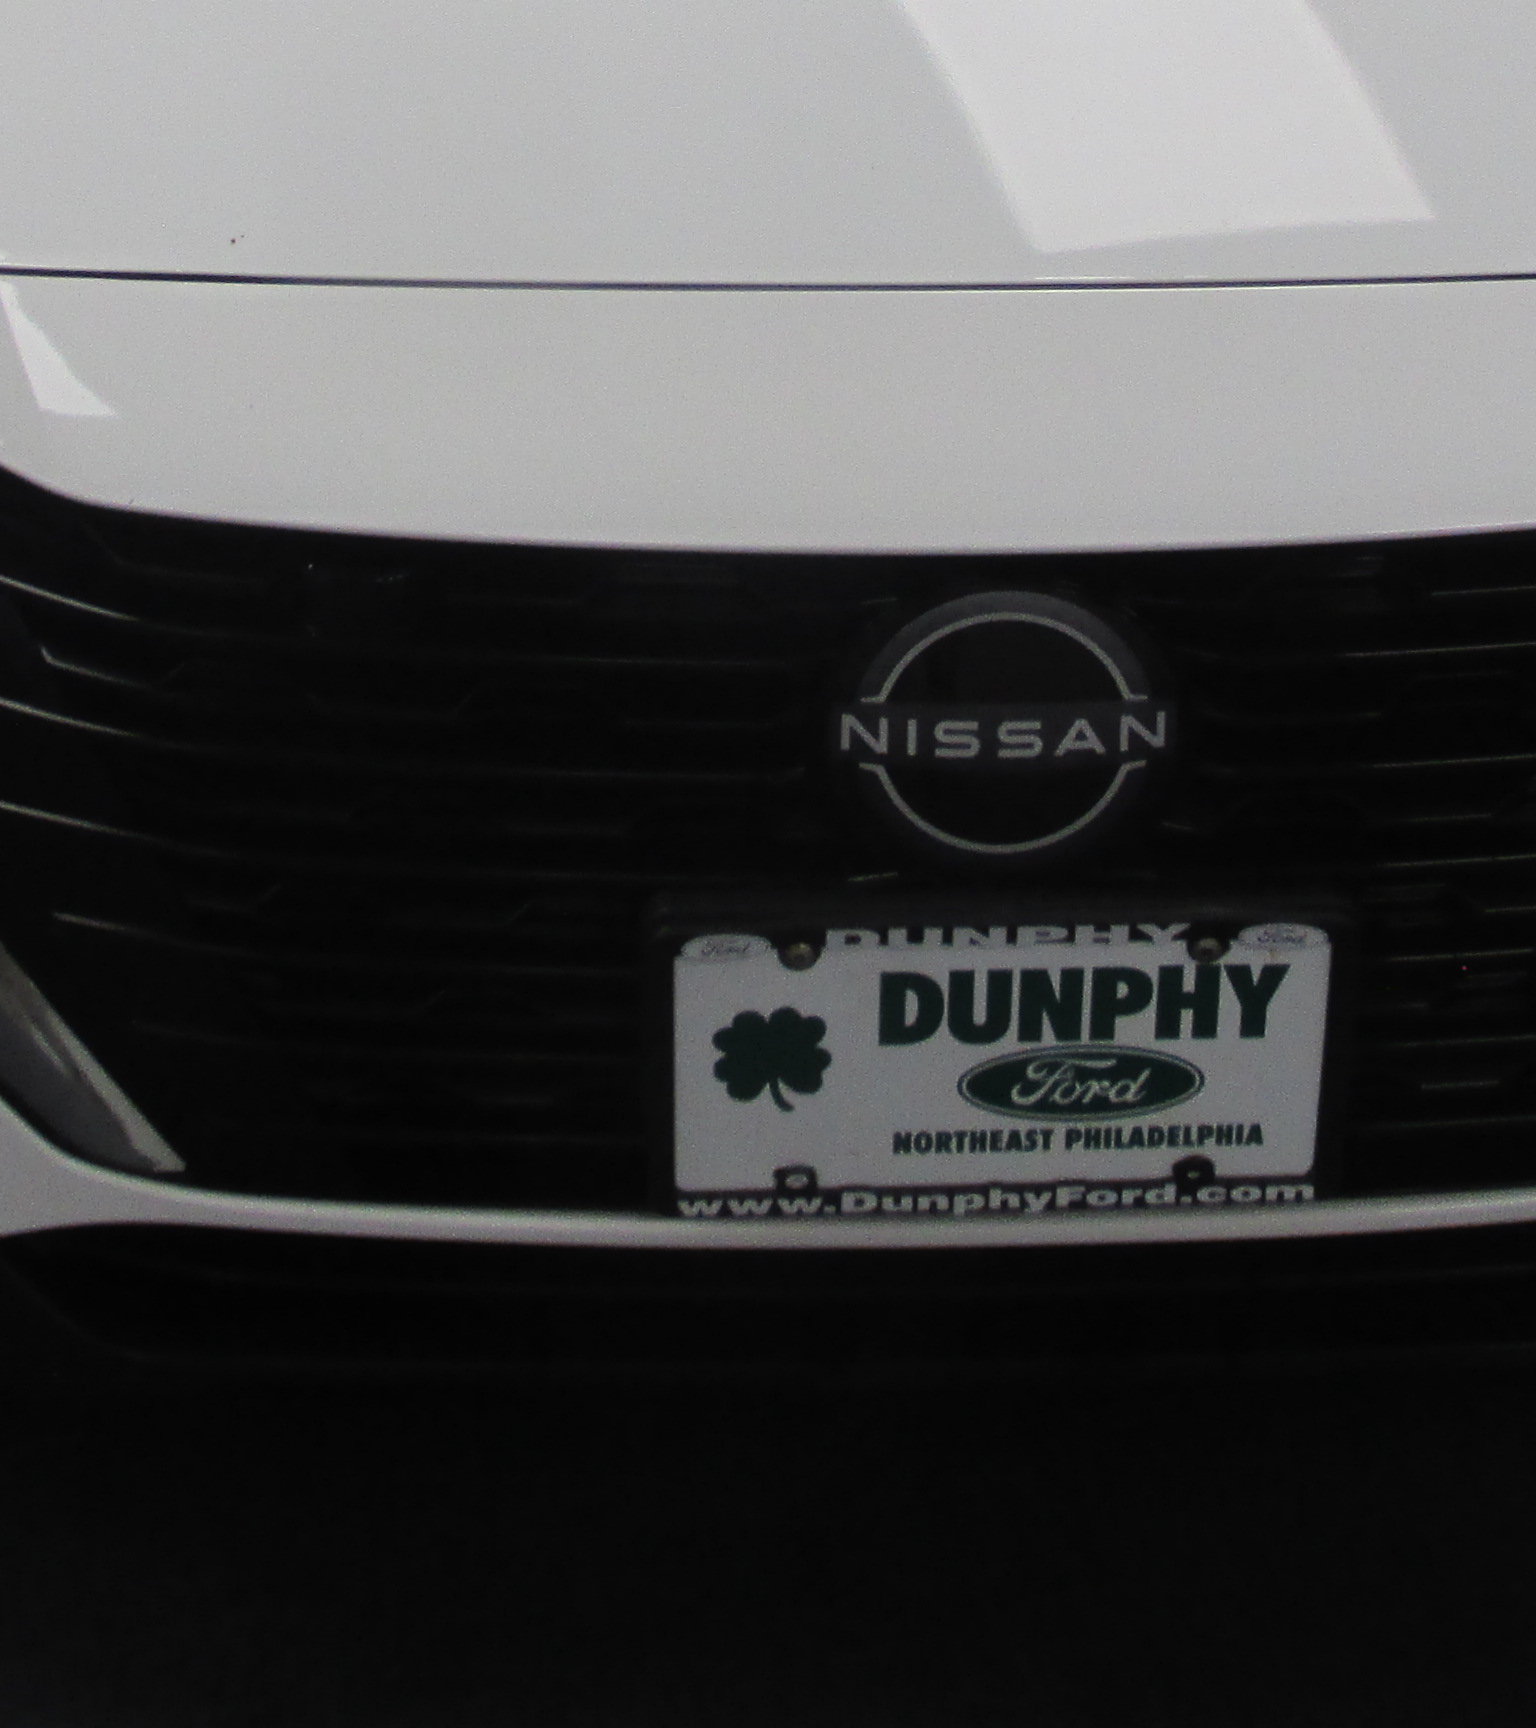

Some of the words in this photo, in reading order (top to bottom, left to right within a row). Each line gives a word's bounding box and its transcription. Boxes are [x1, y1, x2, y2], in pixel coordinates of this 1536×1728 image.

[840, 711, 1166, 758] NISSAN
[878, 964, 1291, 1046] DUNPHY
[1010, 1057, 1152, 1107] Ford
[892, 1128, 1054, 1154] NORTHEAST
[1065, 1123, 1264, 1151] PHILADELPHIA
[677, 1183, 1314, 1216] www.DunphyFord.com
